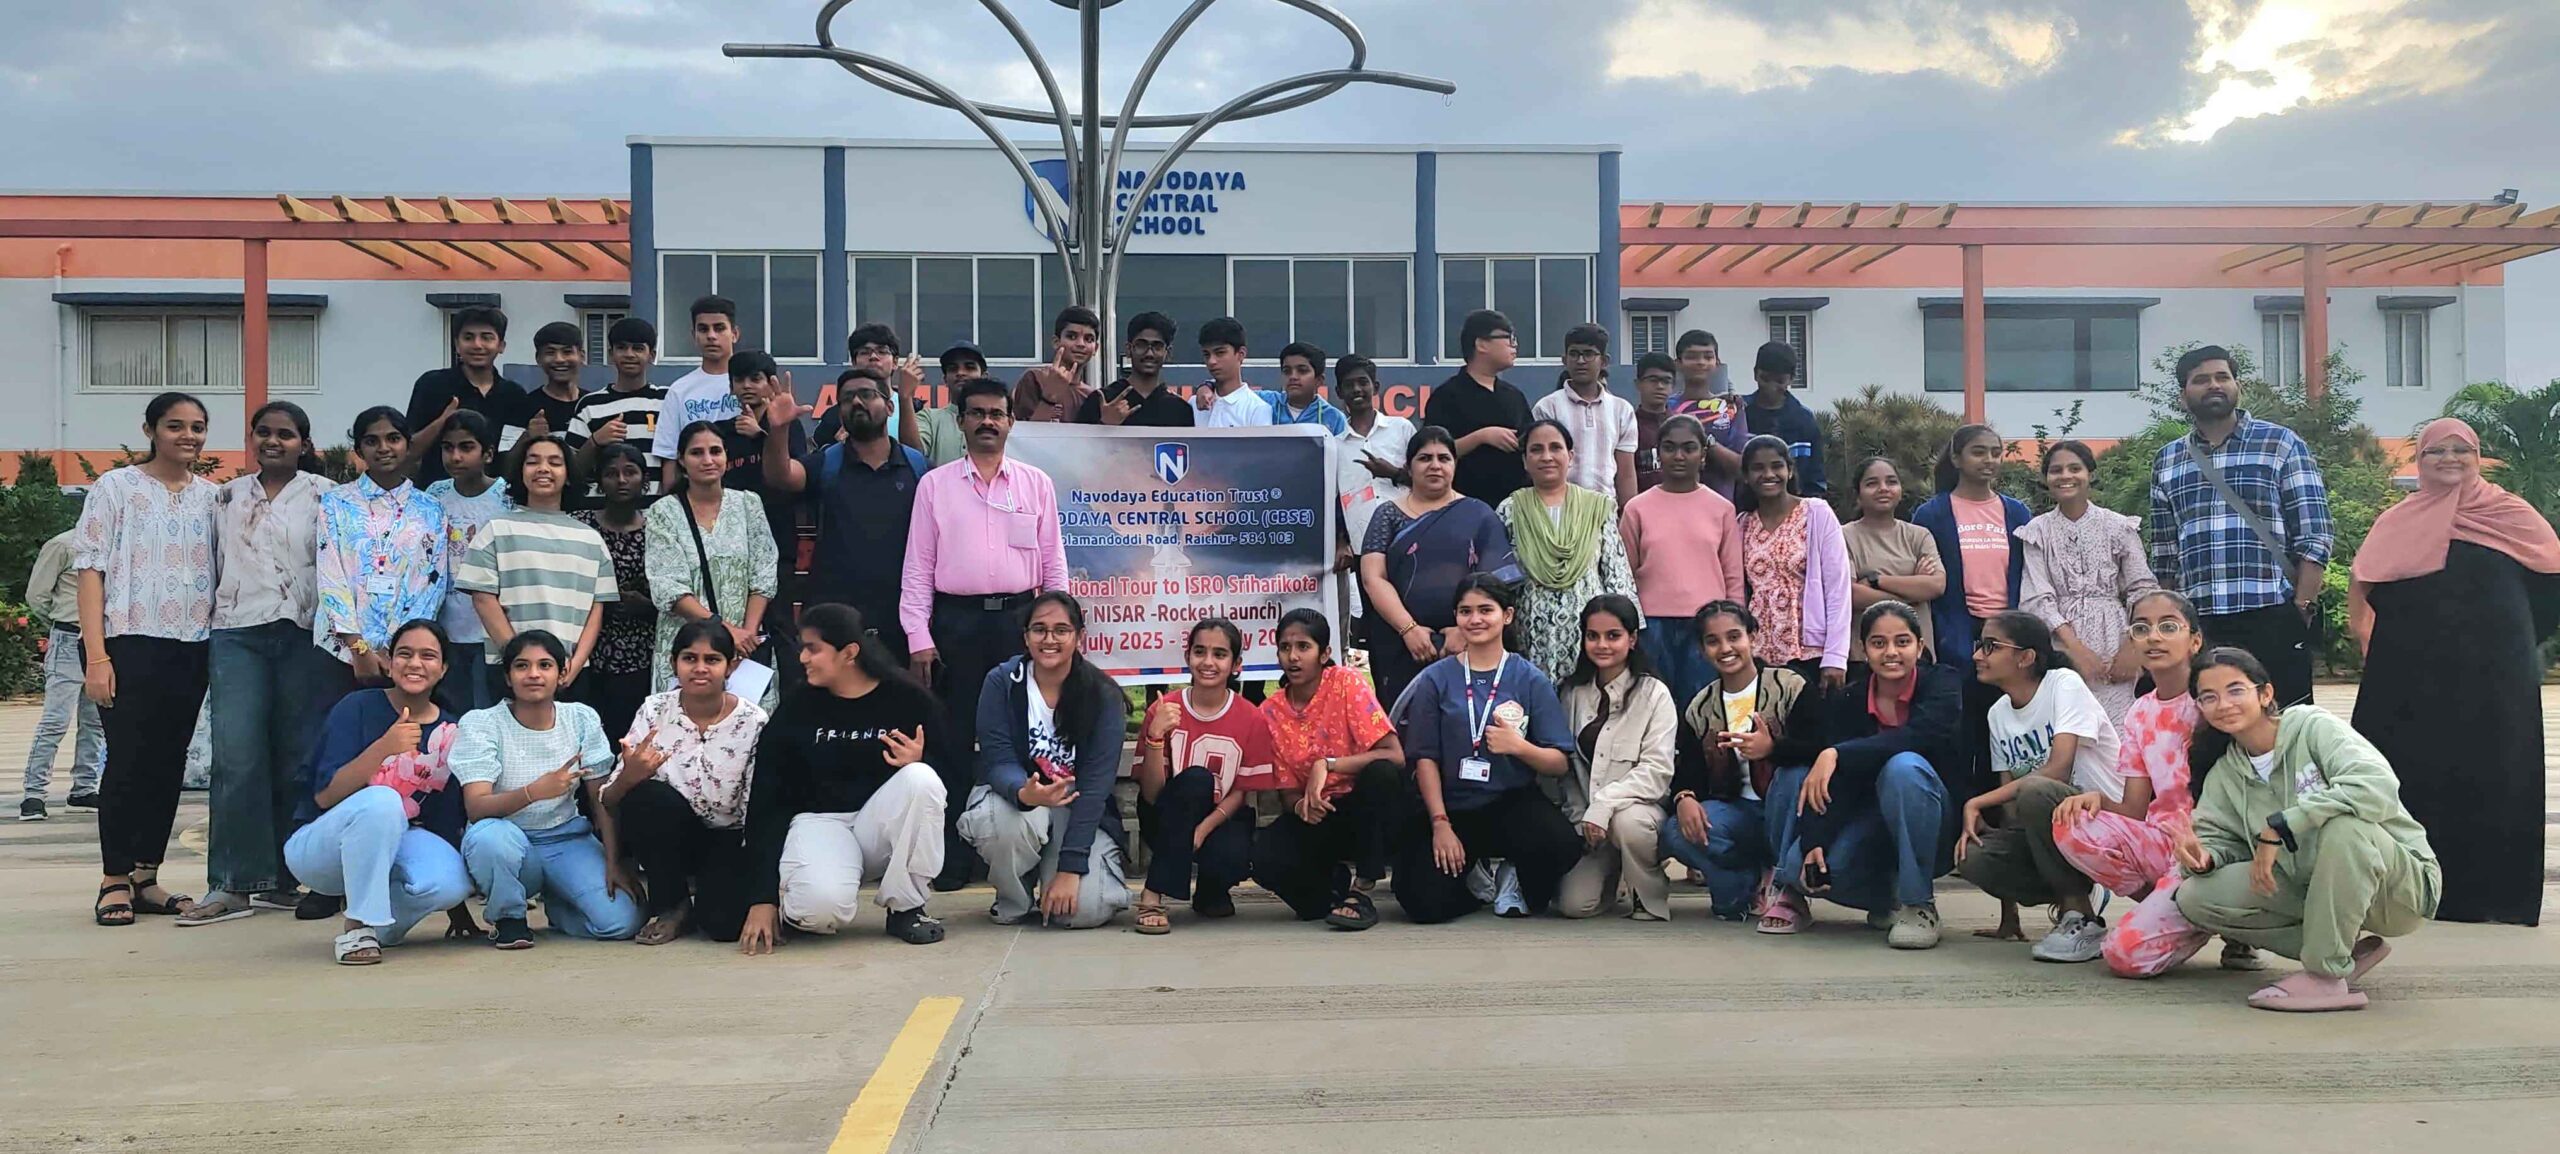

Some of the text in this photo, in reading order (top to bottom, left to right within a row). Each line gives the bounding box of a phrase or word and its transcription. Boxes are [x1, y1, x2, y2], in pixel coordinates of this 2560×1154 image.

[1117, 193, 1219, 213] CNTRAL
[1071, 490, 1146, 505] Navodaya
[1151, 489, 1225, 503] Education
[1229, 489, 1268, 502] Trust
[1058, 509, 1315, 527] ODAYA CENTRAL SCHOOL (CBSE)
[1957, 523, 2007, 534] dore Par
[1061, 534, 1142, 545] olamandoddi
[1146, 534, 1181, 546] Road,
[1239, 532, 1265, 544] 584
[1269, 532, 1295, 544] 103
[1068, 575, 1318, 596] tional Tour to ISRO Sriharikota
[1094, 604, 1145, 623] NISAR
[1220, 602, 1282, 623] Launch)
[1119, 631, 1164, 651] 2025
[1258, 629, 1277, 647] 20
